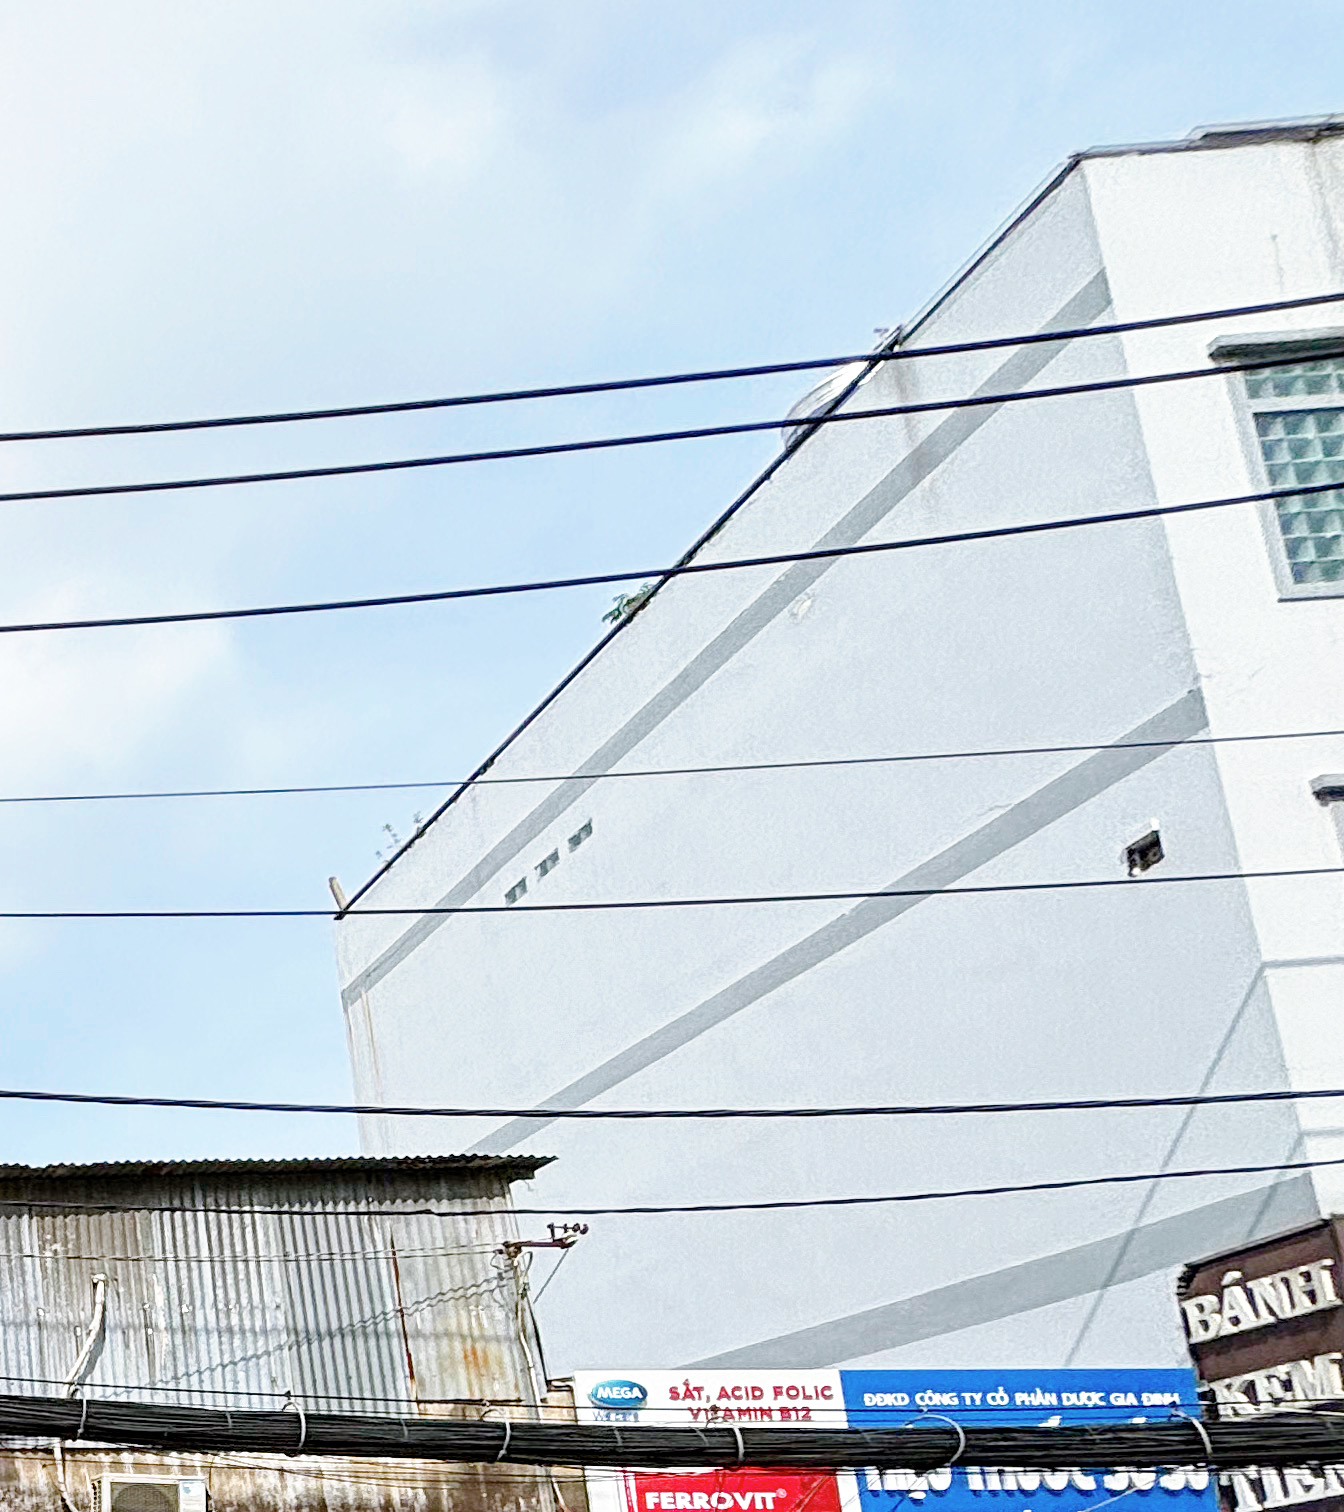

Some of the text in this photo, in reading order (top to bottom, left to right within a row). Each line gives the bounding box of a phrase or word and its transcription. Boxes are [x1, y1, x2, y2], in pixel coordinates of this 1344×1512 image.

[595, 1385, 644, 1401] MEGA
[716, 1385, 765, 1401] ACID
[773, 1384, 835, 1401] FOLIC
[915, 1389, 958, 1407] CÔNG
[961, 1392, 982, 1407] TY
[1110, 1391, 1135, 1407] GIA
[688, 1406, 812, 1423] VITAMIN B12
